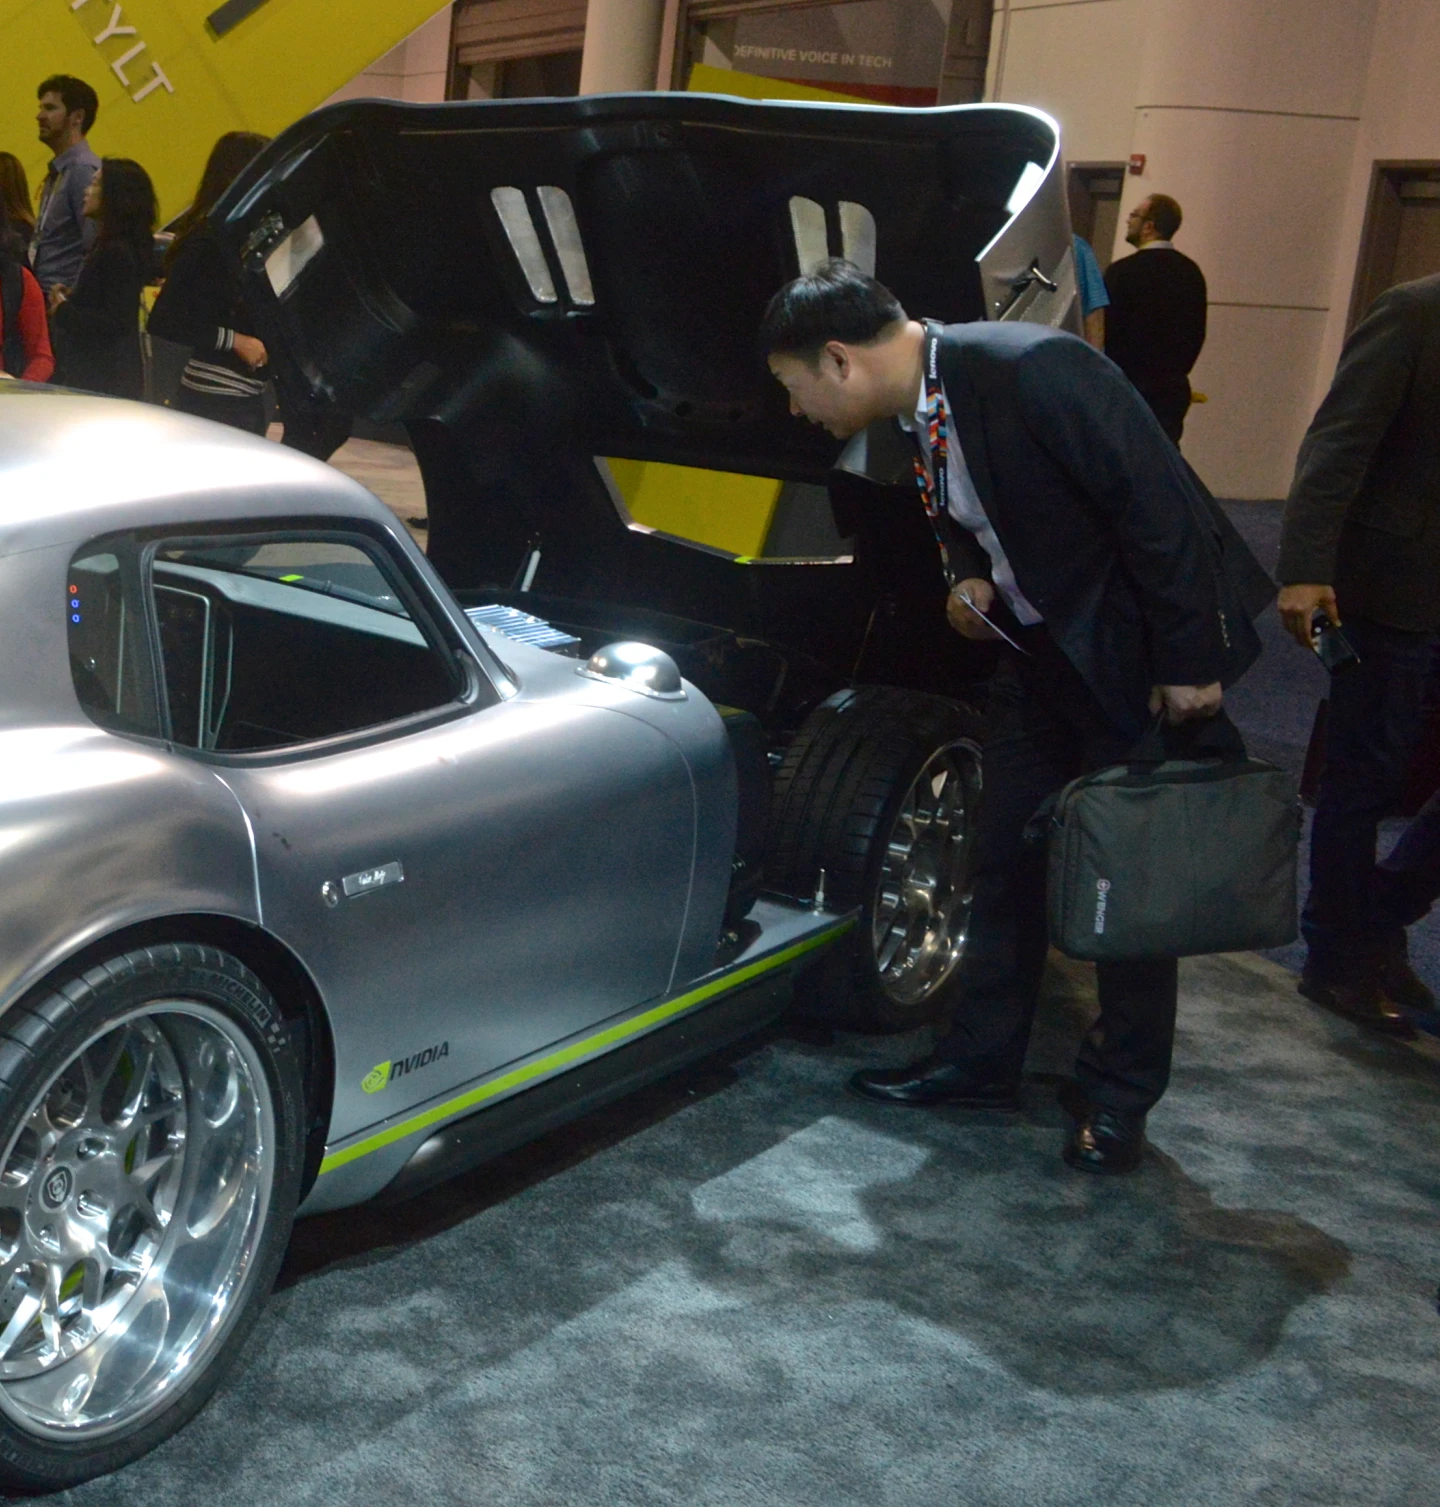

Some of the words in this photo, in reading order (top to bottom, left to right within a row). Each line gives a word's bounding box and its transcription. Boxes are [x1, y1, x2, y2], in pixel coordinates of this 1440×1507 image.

[799, 50, 838, 64] VOICE
[841, 53, 855, 65] IN
[859, 55, 892, 68] TECH
[928, 337, 938, 379] lenovo
[1094, 891, 1108, 934] WENGER
[389, 1041, 449, 1081] NVIDIA
